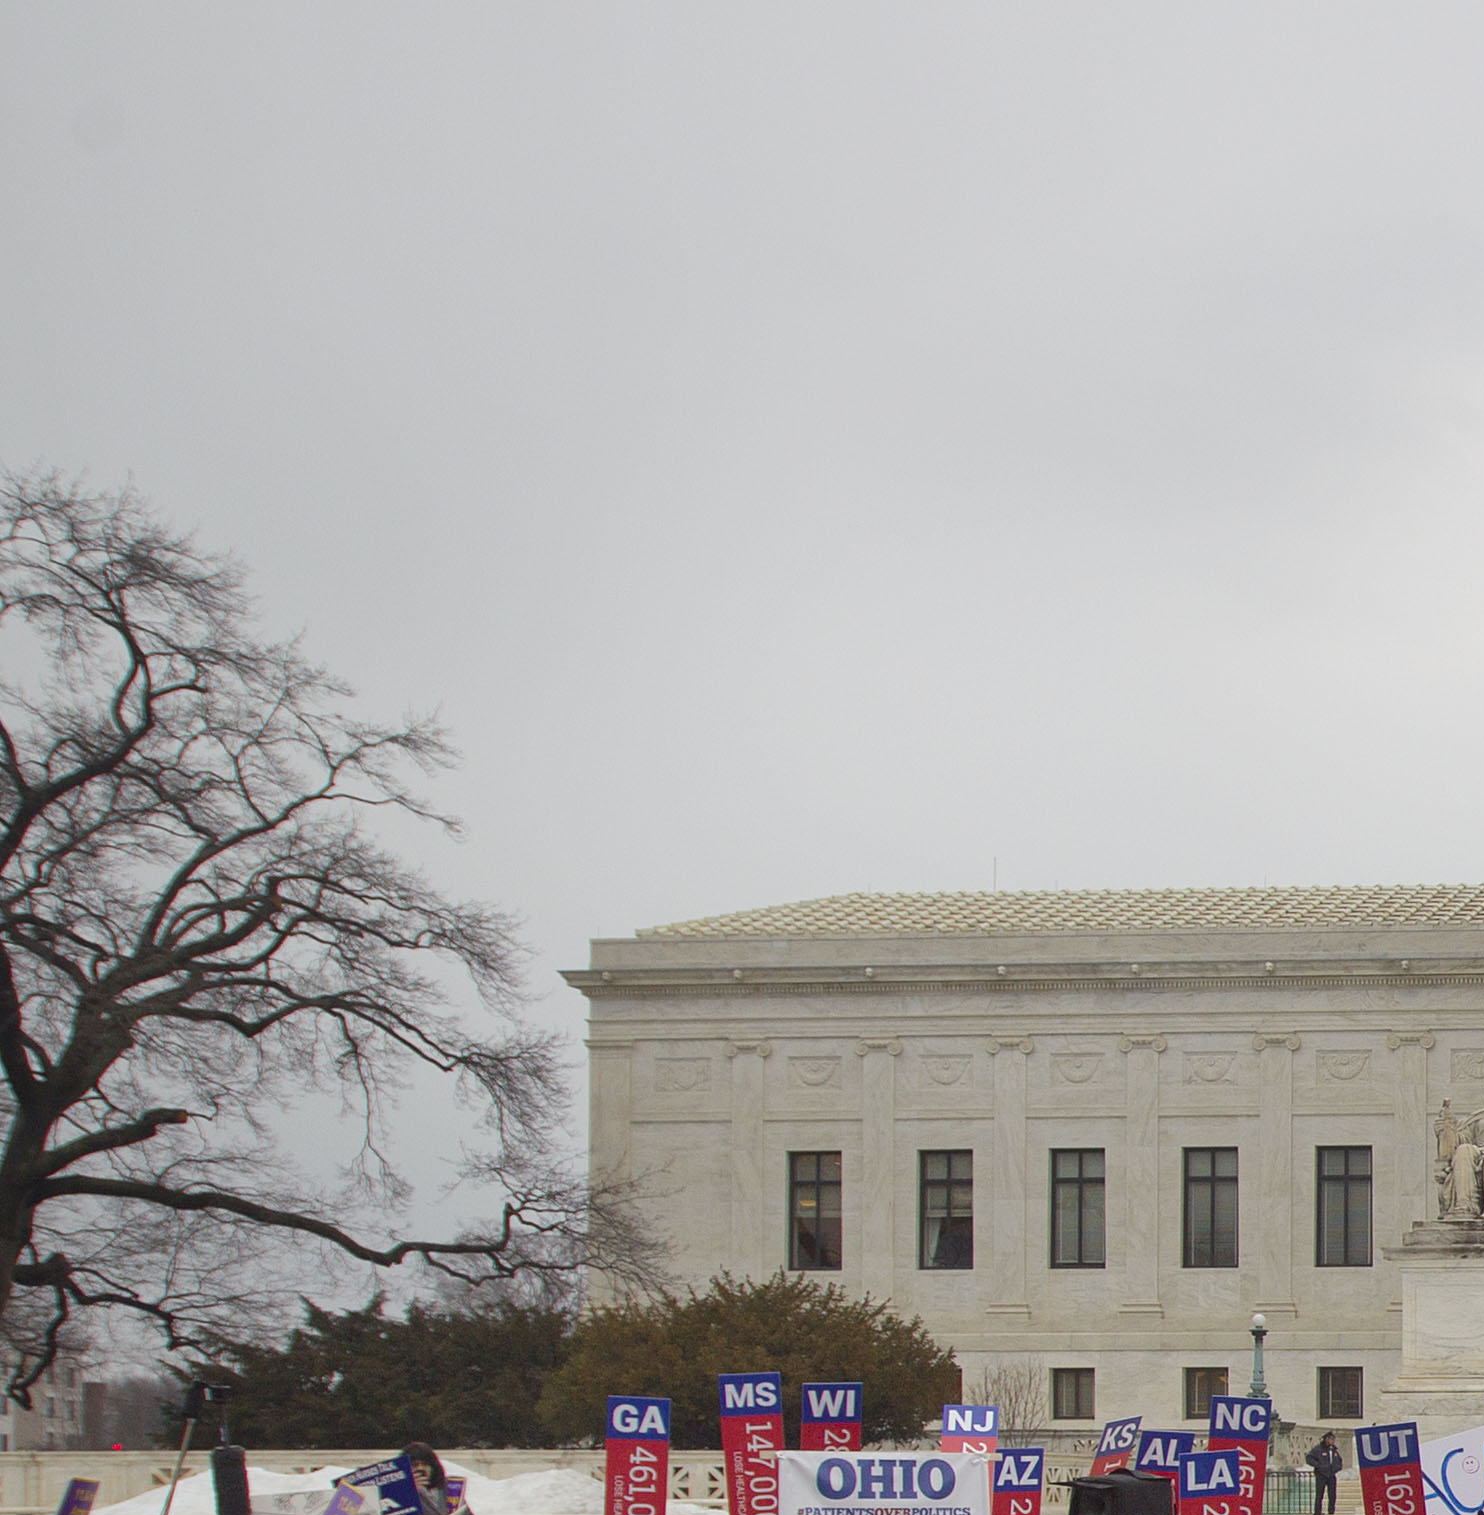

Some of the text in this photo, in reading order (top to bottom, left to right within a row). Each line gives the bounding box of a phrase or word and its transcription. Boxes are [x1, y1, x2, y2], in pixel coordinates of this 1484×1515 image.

[724, 1382, 777, 1409] MS
[808, 1390, 855, 1417] WI
[612, 1404, 666, 1434] GA
[948, 1410, 994, 1432] NJ
[1215, 1403, 1267, 1432] NC
[1101, 1423, 1136, 1452] KS
[1140, 1438, 1180, 1466] AL
[1361, 1429, 1414, 1461] UT
[733, 1452, 743, 1475] LOSE
[997, 1455, 1040, 1487] AZ
[1187, 1459, 1234, 1491] LA
[614, 1475, 624, 1497] LOSE
[816, 1458, 956, 1500] OHIO
